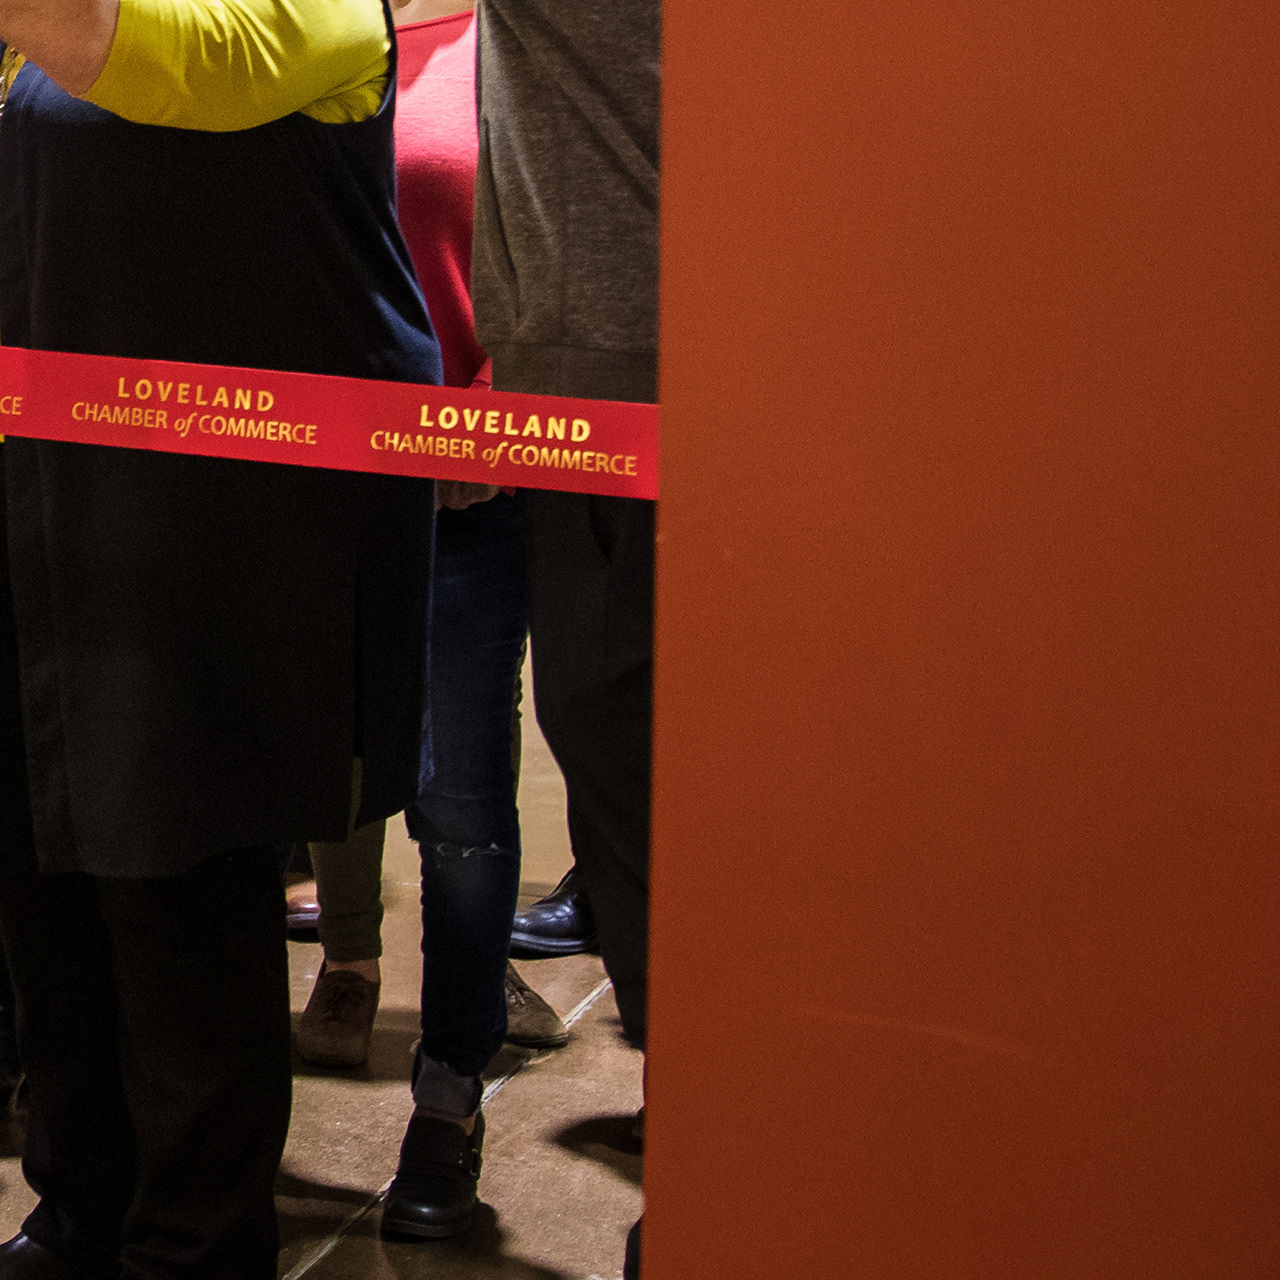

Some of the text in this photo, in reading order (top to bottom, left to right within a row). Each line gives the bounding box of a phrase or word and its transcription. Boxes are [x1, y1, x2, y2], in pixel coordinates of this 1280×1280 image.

[117, 377, 275, 412] LOVELAND
[71, 401, 318, 445] CHAMBER of COMMERCE
[419, 404, 592, 442] LOVELAND
[369, 430, 639, 476] CHAMBER of COMMERCE
